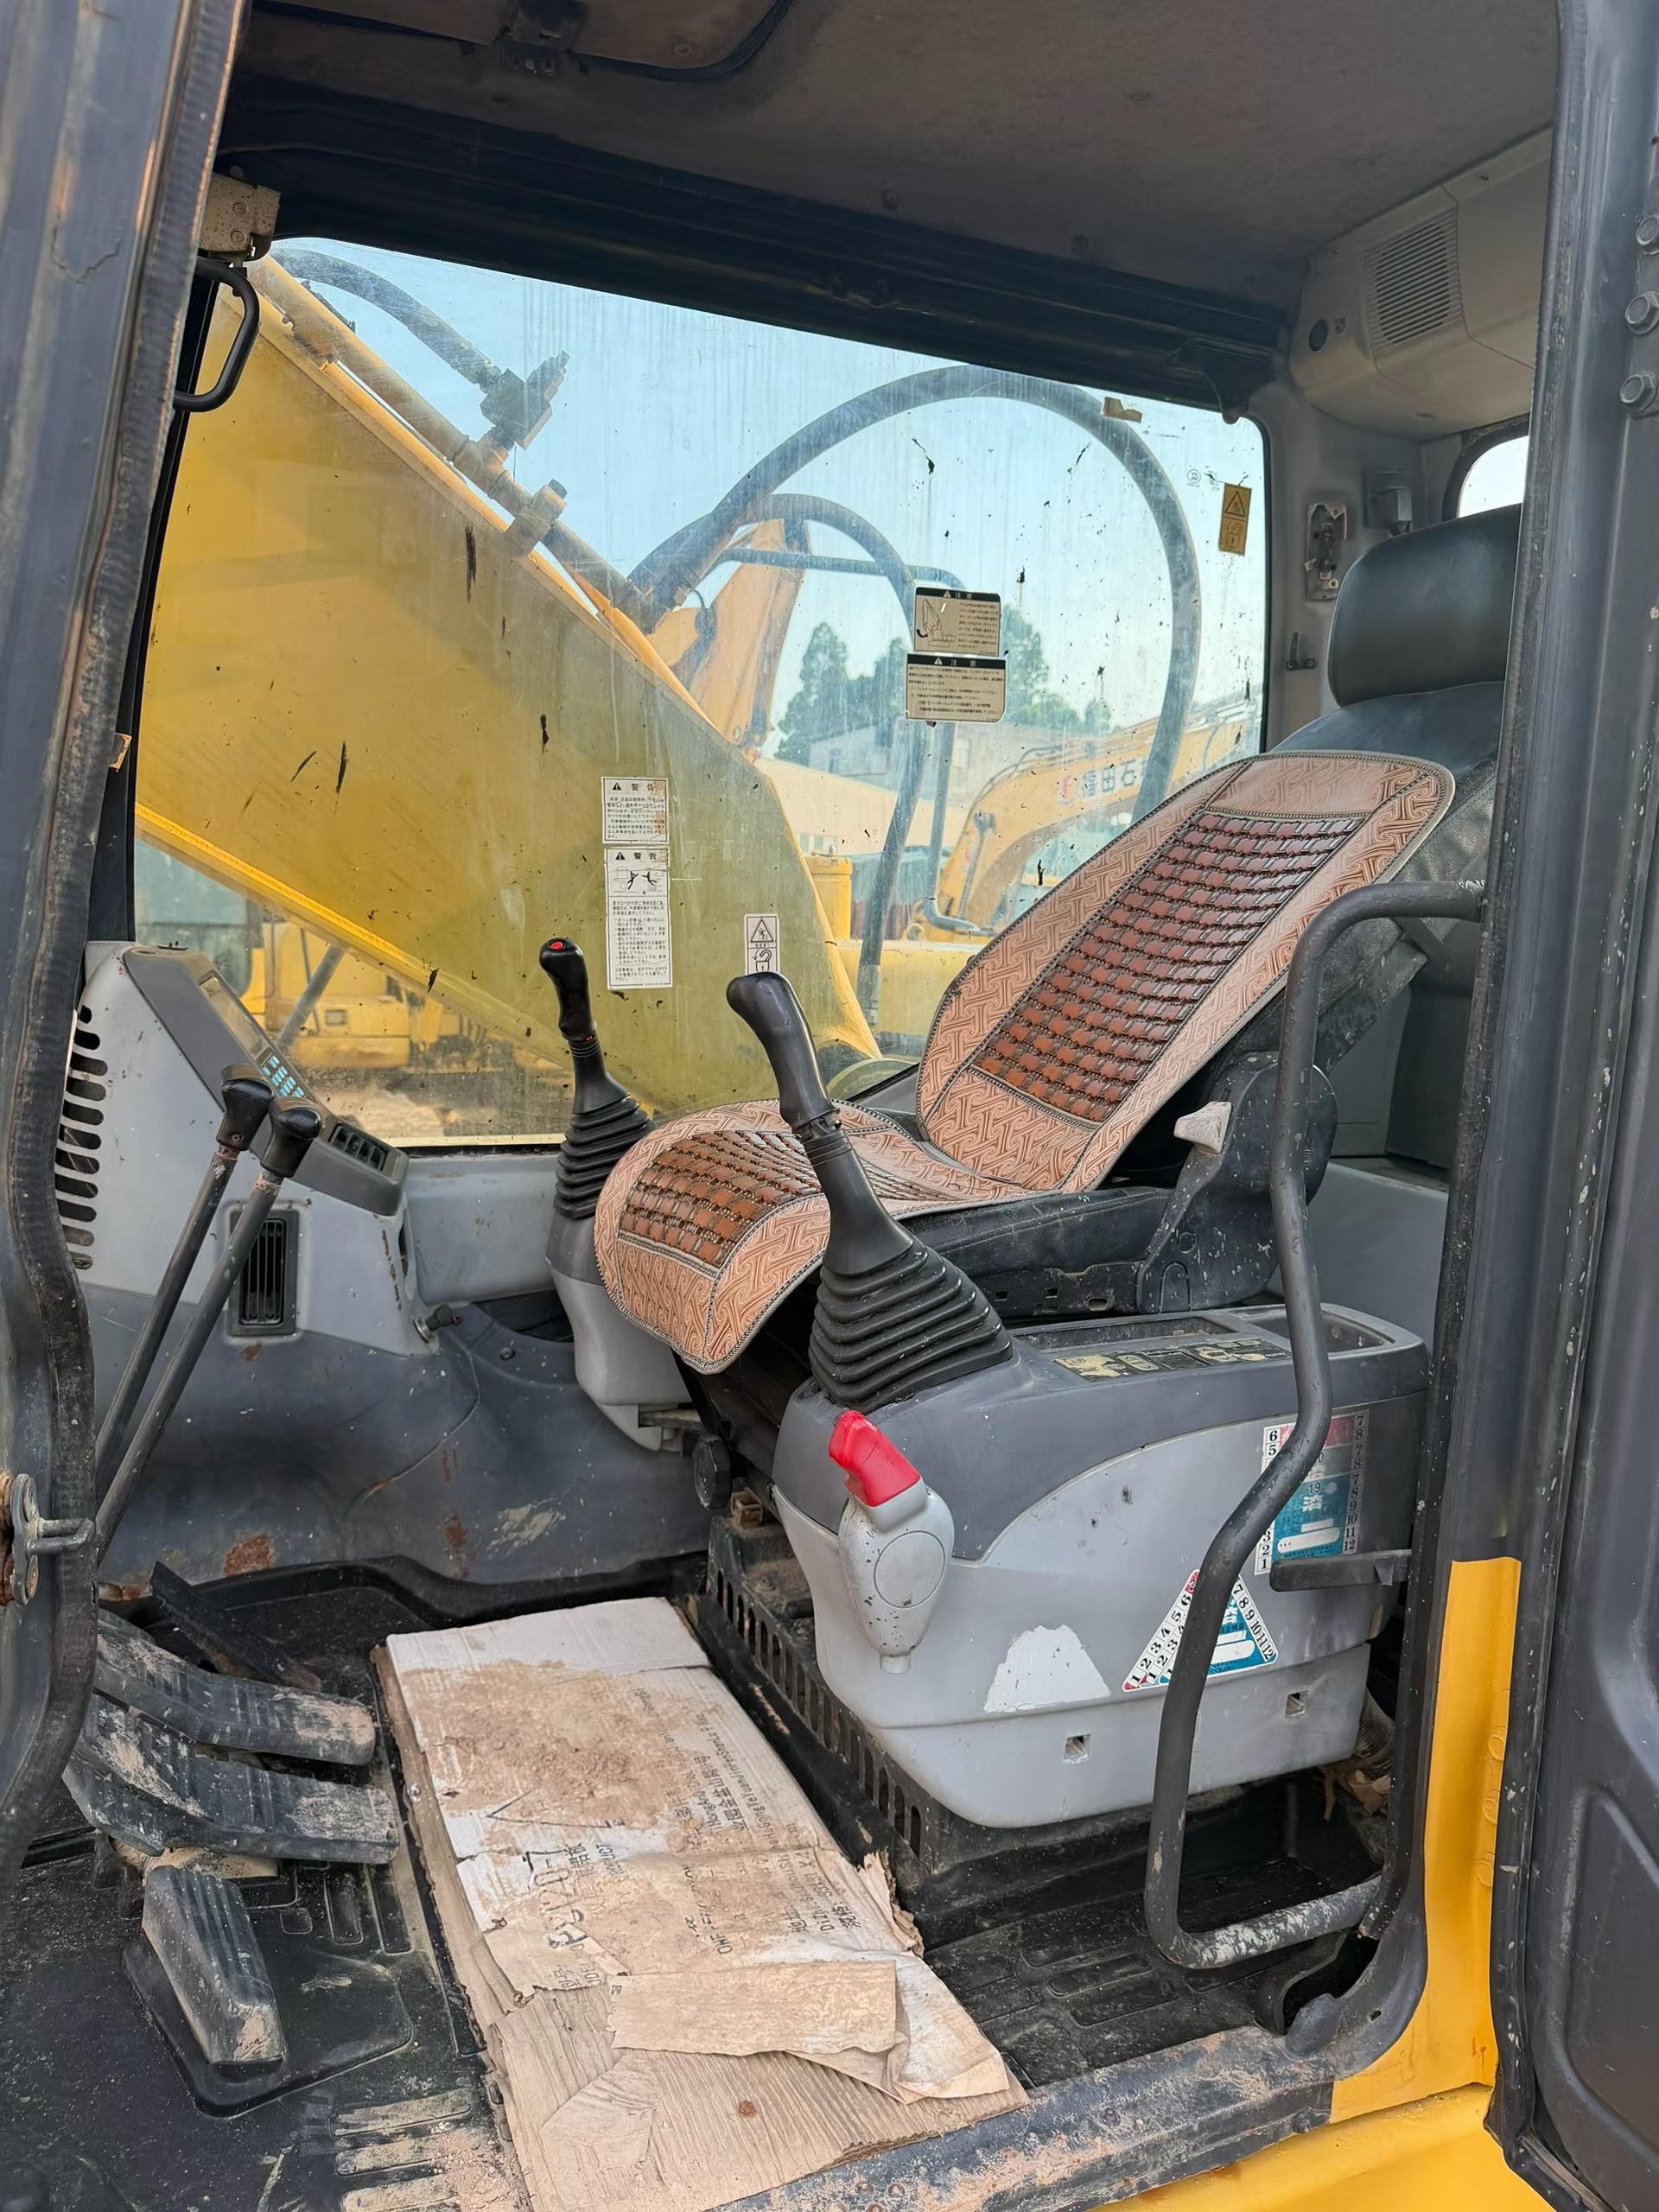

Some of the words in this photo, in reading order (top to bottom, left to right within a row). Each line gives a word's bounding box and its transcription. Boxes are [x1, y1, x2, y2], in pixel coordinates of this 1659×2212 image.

[1357, 1415, 1364, 1426] 7
[1269, 1430, 1278, 1441] 6
[1355, 1429, 1363, 1440] 8
[1268, 1445, 1277, 1456] 5
[1355, 1445, 1363, 1456] 7
[1353, 1458, 1362, 1469] 8
[1352, 1474, 1359, 1484] 7
[1308, 1482, 1321, 1494] 19
[1351, 1487, 1358, 1498] 8
[1350, 1501, 1357, 1512] 9
[1347, 1514, 1357, 1525] 10
[1345, 1527, 1356, 1538] 11
[1262, 1545, 1270, 1555] 2
[1344, 1540, 1355, 1551] 12
[1262, 1559, 1267, 1569] 1
[1233, 1584, 1243, 1595] 7
[1238, 1597, 1249, 1609] 8
[1245, 1609, 1255, 1620] 9
[1250, 1621, 1262, 1635] 10
[1130, 1675, 1141, 1683] 1
[1141, 1657, 1152, 1669] 2
[1150, 1642, 1161, 1653] 3
[1160, 1628, 1171, 1637] 4
[1171, 1611, 1181, 1622] 5
[1181, 1594, 1191, 1605] 6
[1255, 1632, 1268, 1647] 11
[1156, 1655, 1168, 1667] 2
[1167, 1639, 1178, 1650] 3
[1262, 1643, 1274, 1659] 12
